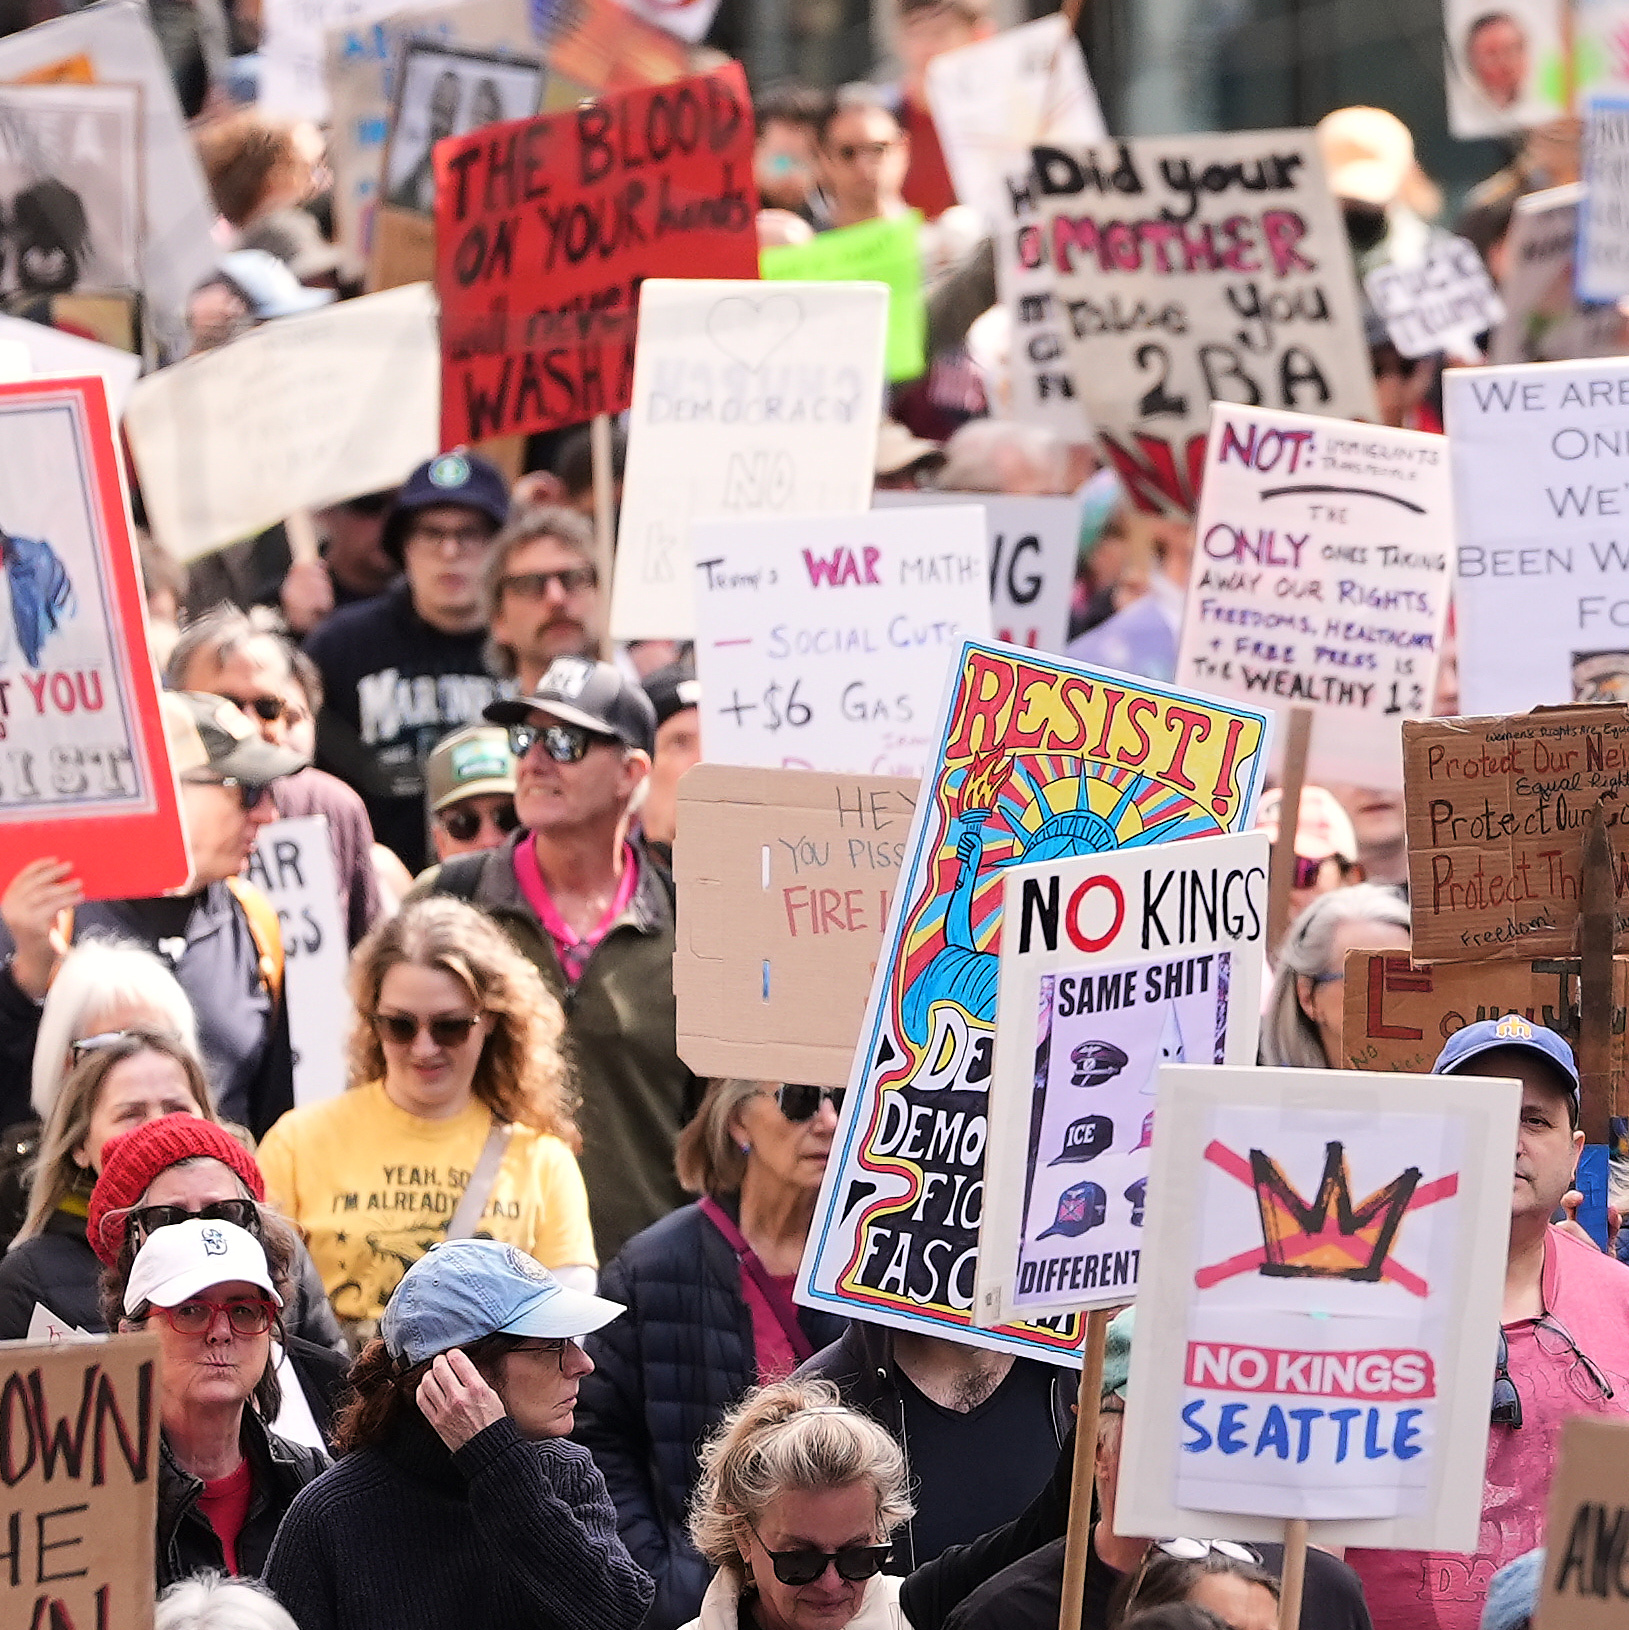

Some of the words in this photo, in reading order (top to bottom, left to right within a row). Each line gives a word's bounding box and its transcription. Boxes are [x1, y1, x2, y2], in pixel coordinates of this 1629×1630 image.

[449, 124, 552, 220] THE
[574, 81, 745, 186] BLOOD
[1028, 139, 1144, 196] Did
[1160, 152, 1305, 222] your
[454, 217, 518, 287] ON
[538, 179, 649, 271] YOUR
[1052, 209, 1318, 276] MOTHER
[1224, 281, 1331, 351] you
[462, 346, 602, 441] WASH
[1135, 342, 1187, 420] 2
[1280, 347, 1332, 404] A
[1471, 379, 1546, 414] WE
[1219, 422, 1316, 475] NOT:
[801, 545, 882, 589] WAR
[1204, 523, 1310, 568] ONLY
[1456, 545, 1574, 578] BEEN
[1275, 577, 1325, 601] OUR
[767, 622, 879, 659] SOCIAL
[1234, 637, 1295, 664] FREE
[22, 669, 105, 715] YOU
[1240, 664, 1376, 708] WEALTHY
[944, 650, 1248, 818] RESIST!
[1428, 743, 1525, 781] Protect
[1533, 739, 1579, 773] Our
[1516, 773, 1582, 800] Equal
[1428, 798, 1556, 847] Protect
[1556, 794, 1592, 830] Our
[777, 836, 830, 874] YOU
[1431, 850, 1539, 916] Protect
[1538, 848, 1584, 901] Th
[782, 884, 870, 938] FIRE
[1018, 874, 1125, 954] NO
[1141, 867, 1265, 950] KINGS
[1460, 906, 1560, 948] Freedom!
[1058, 970, 1138, 1017] SAME
[1144, 954, 1214, 1003] SHIT
[1066, 1123, 1096, 1148] ICE
[1018, 1249, 1139, 1295] DIFFERENT
[1191, 1348, 1270, 1392] NO
[1274, 1351, 1428, 1394] KINGS
[1180, 1399, 1426, 1465] SEATTLE
